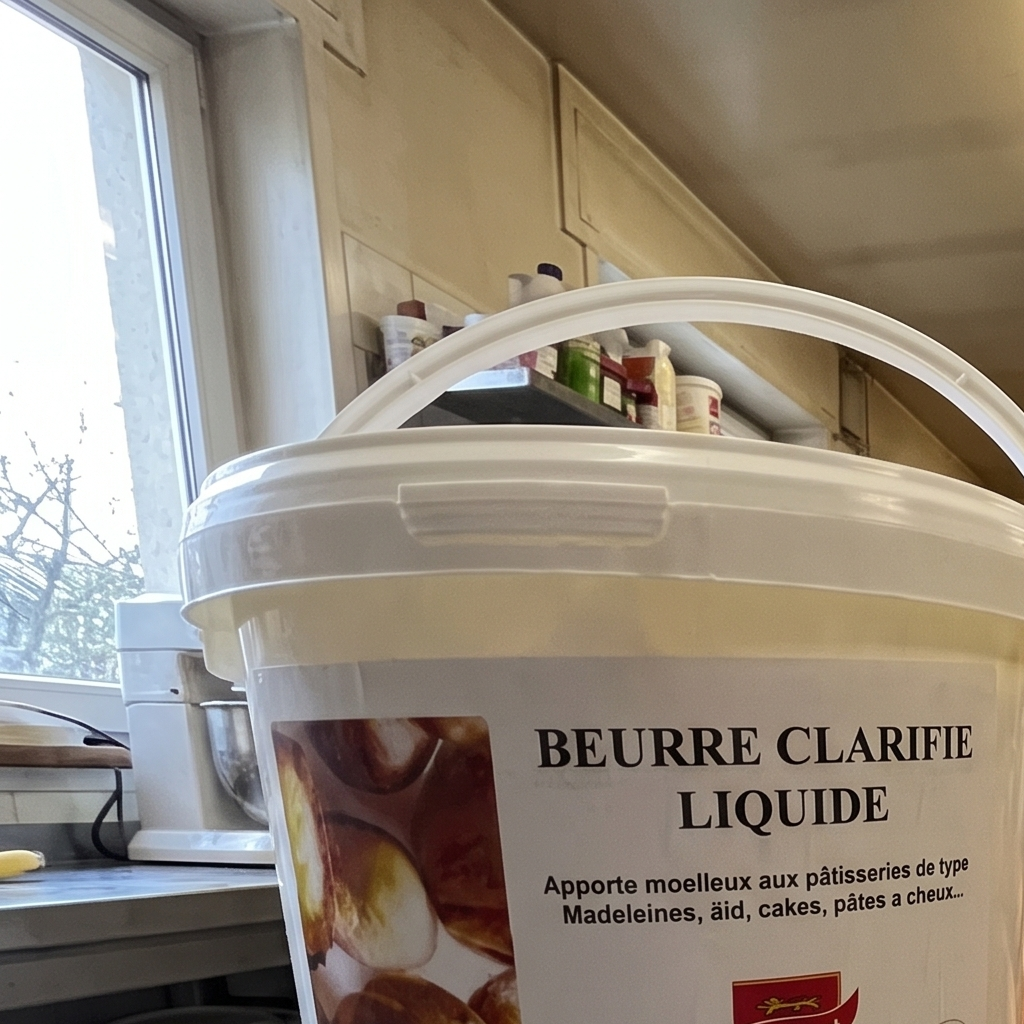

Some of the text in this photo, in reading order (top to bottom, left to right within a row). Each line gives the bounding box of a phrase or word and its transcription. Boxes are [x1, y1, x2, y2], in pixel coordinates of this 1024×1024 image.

[533, 725, 973, 769] BEURRE CLARIFIE
[676, 785, 889, 837] LIQUIDE
[543, 857, 969, 901] Apporte moelleux aux pâtisseries de type
[562, 902, 703, 926] Madeleines,
[758, 897, 828, 919] cakes,
[834, 892, 887, 918] pâtes
[891, 892, 902, 908] a
